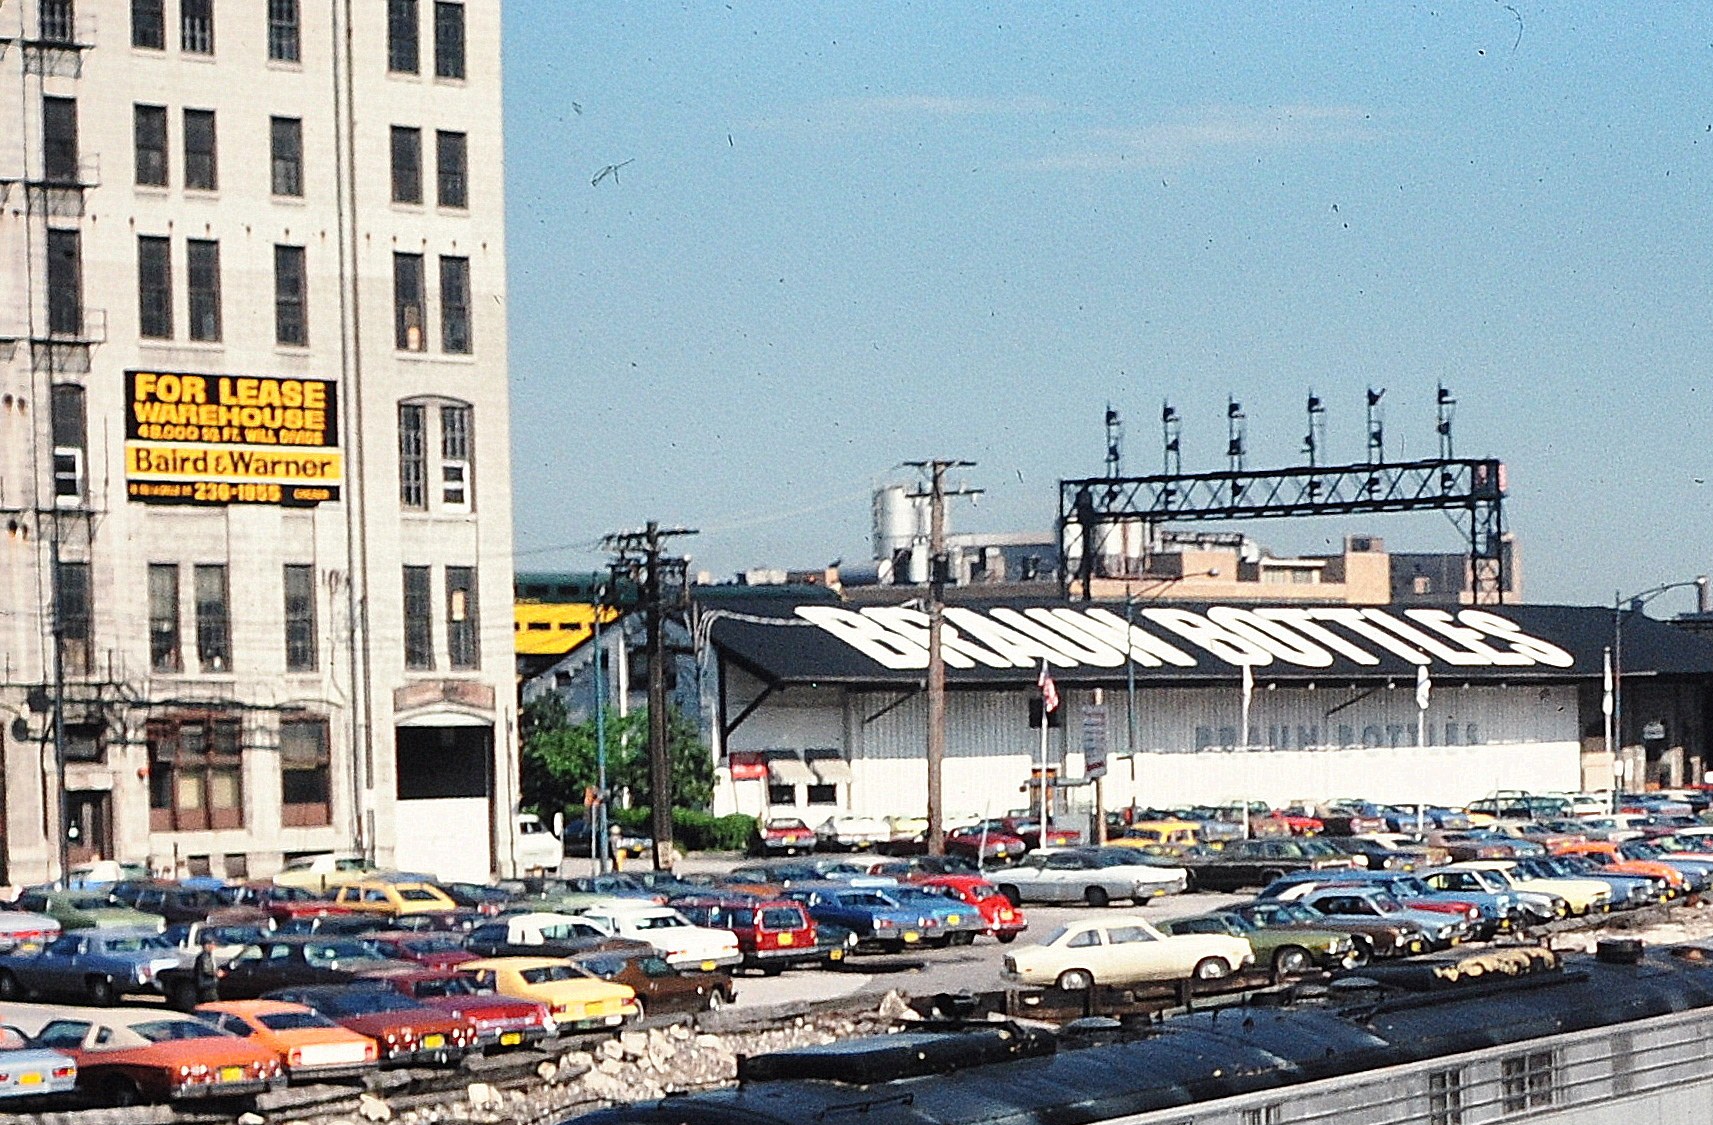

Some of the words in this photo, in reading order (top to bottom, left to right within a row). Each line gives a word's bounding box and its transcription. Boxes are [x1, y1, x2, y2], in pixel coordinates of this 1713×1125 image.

[135, 373, 206, 404] FOR
[218, 377, 326, 409] LEASE
[133, 401, 326, 430] WAREHOUSE
[135, 447, 208, 473] Baird
[214, 451, 227, 475] &
[229, 450, 332, 477] Warner
[795, 606, 1198, 669] BRAUN
[1141, 605, 1575, 668] BOTTLES
